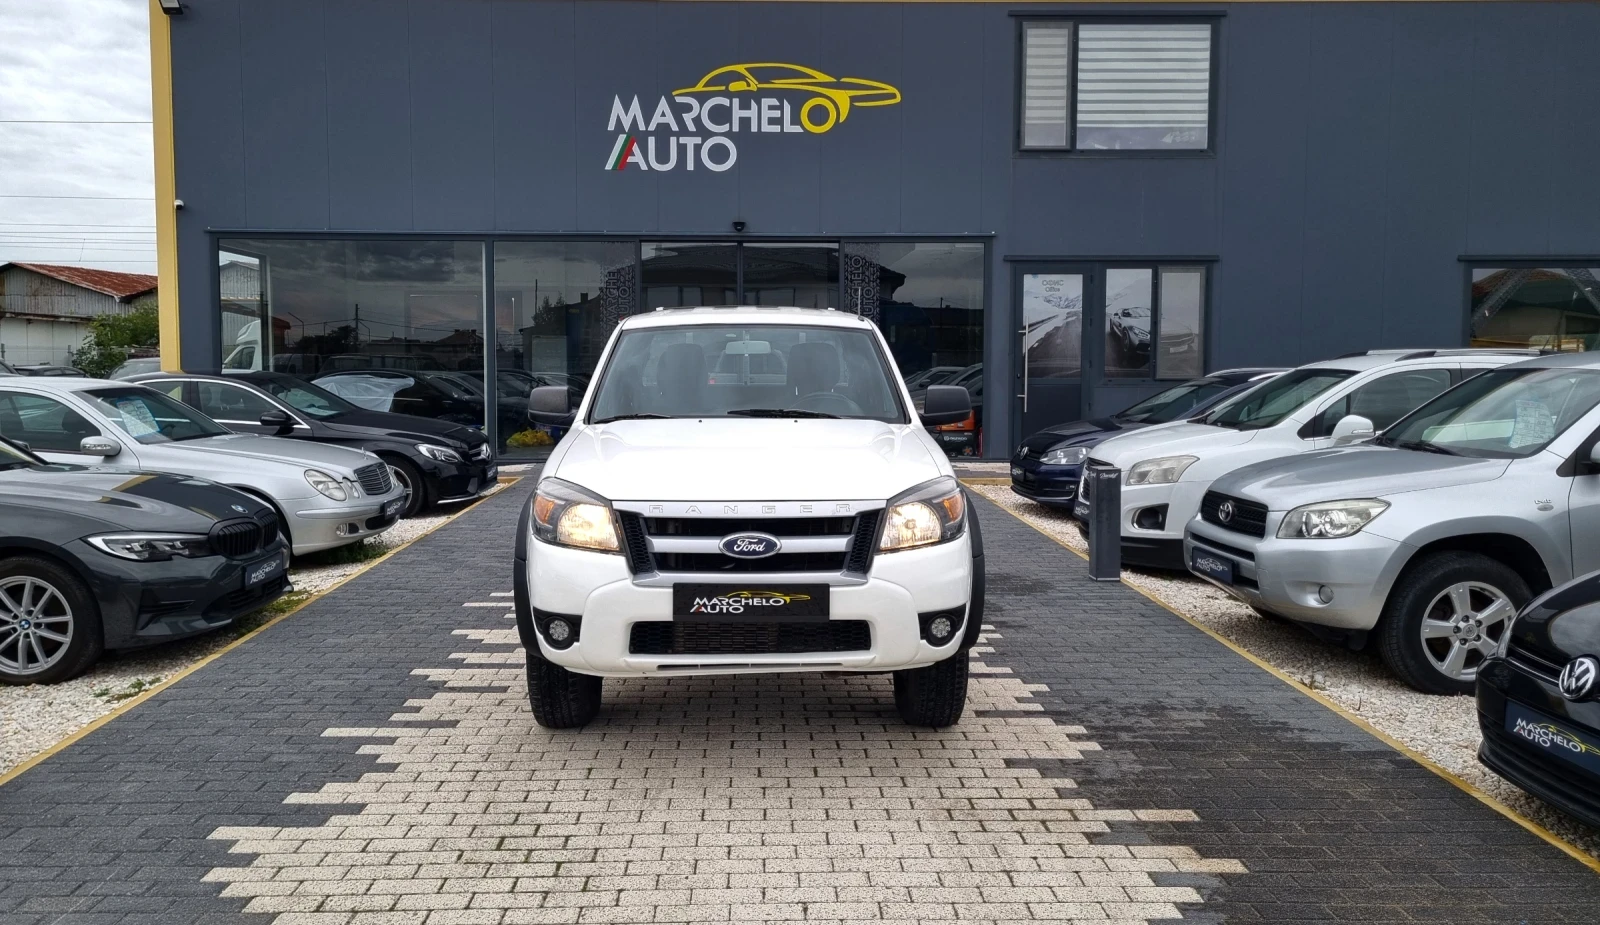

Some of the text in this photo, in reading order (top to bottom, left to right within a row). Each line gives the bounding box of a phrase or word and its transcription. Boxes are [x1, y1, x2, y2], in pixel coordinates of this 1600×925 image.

[607, 94, 837, 134] MARCHELO
[604, 134, 737, 172] AUTO
[648, 503, 852, 515] RANGER
[733, 538, 767, 553] Ford
[690, 604, 744, 614] AUTO
[693, 597, 785, 606] MARCHELO
[1513, 724, 1551, 748] AUTO
[1516, 717, 1582, 753] MARCHELO
